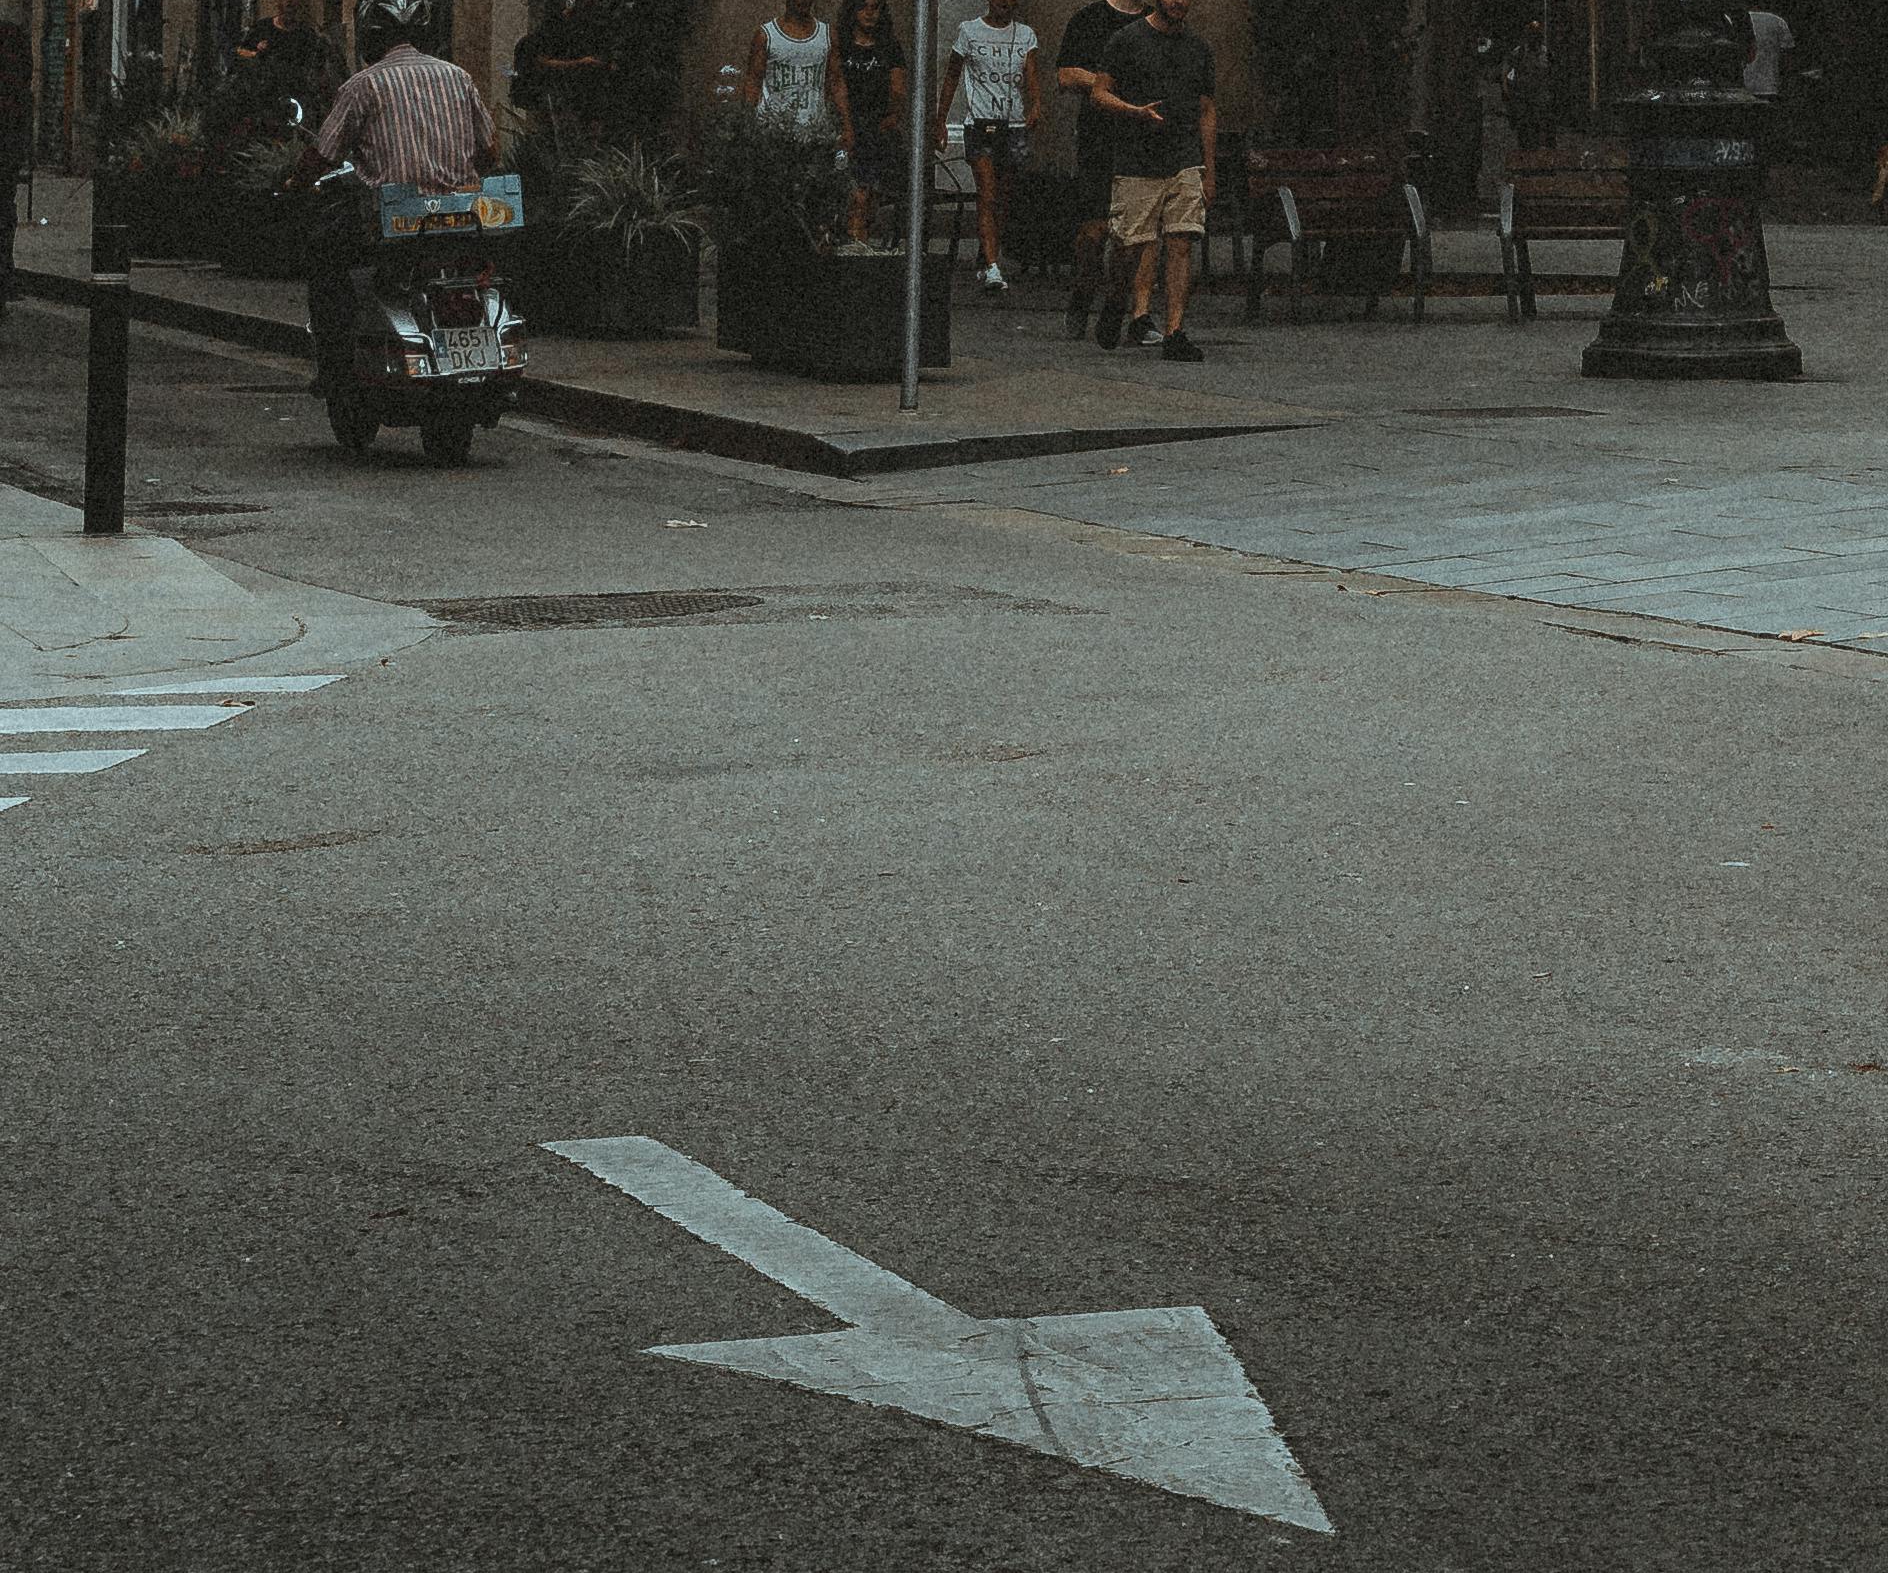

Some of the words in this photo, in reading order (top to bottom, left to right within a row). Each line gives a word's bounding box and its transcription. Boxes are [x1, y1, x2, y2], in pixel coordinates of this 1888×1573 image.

[979, 72, 1022, 85] COCO
[448, 329, 490, 348] 4651
[451, 350, 486, 369] DKJ
